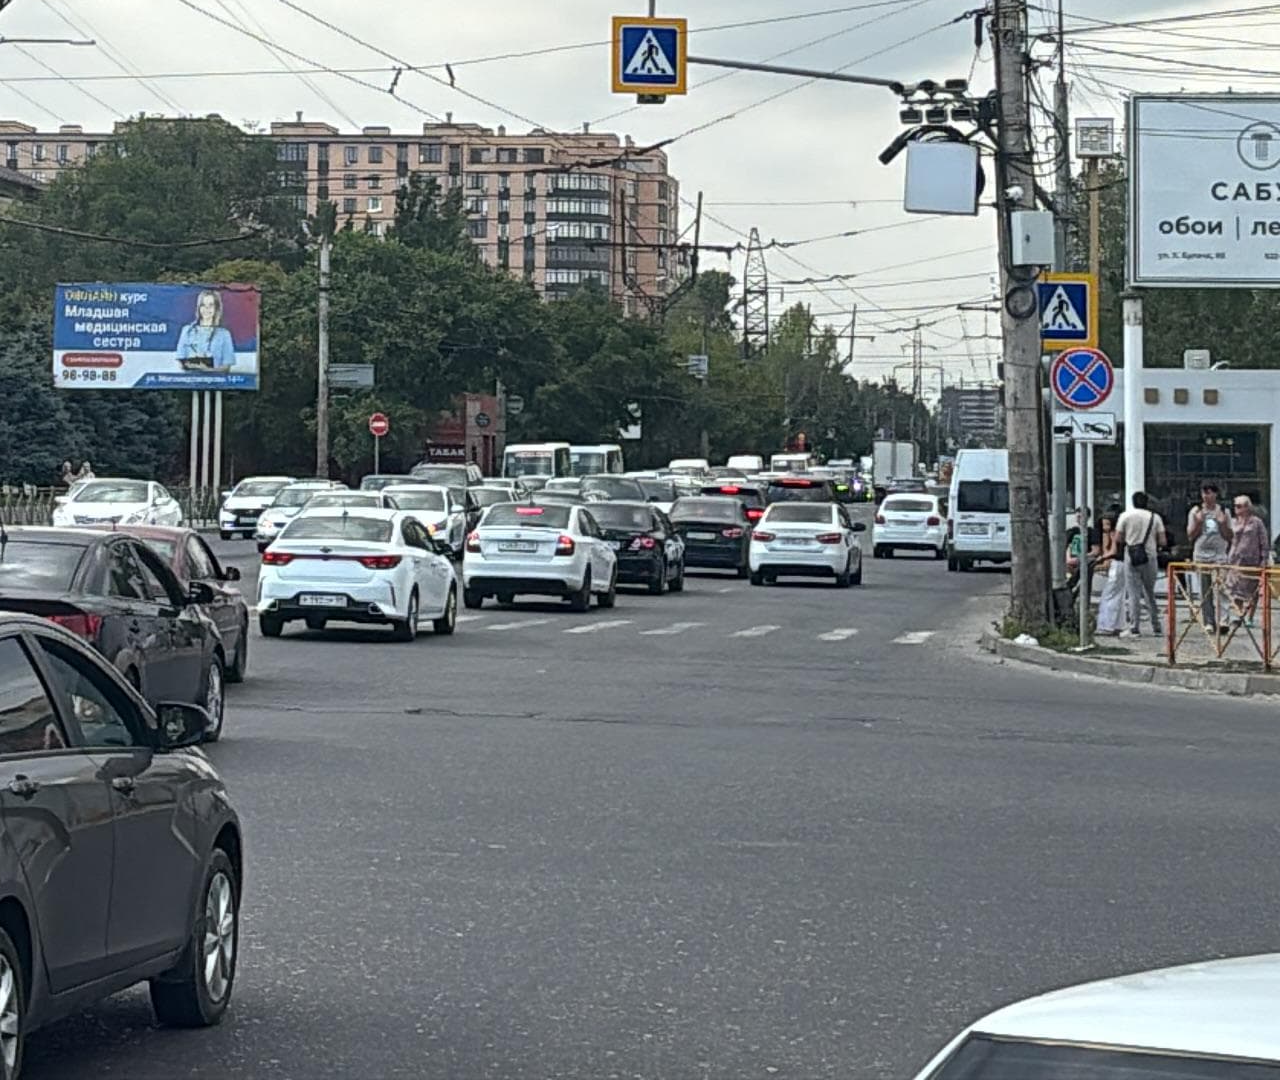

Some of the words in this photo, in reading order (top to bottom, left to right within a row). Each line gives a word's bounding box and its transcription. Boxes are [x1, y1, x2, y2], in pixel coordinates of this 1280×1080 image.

[1158, 215, 1223, 236] обои
[120, 293, 148, 305] курс
[64, 305, 129, 319] Младшая
[74, 322, 168, 335] медицинская
[92, 336, 141, 350] сестра
[429, 447, 465, 457] ТАБАК
